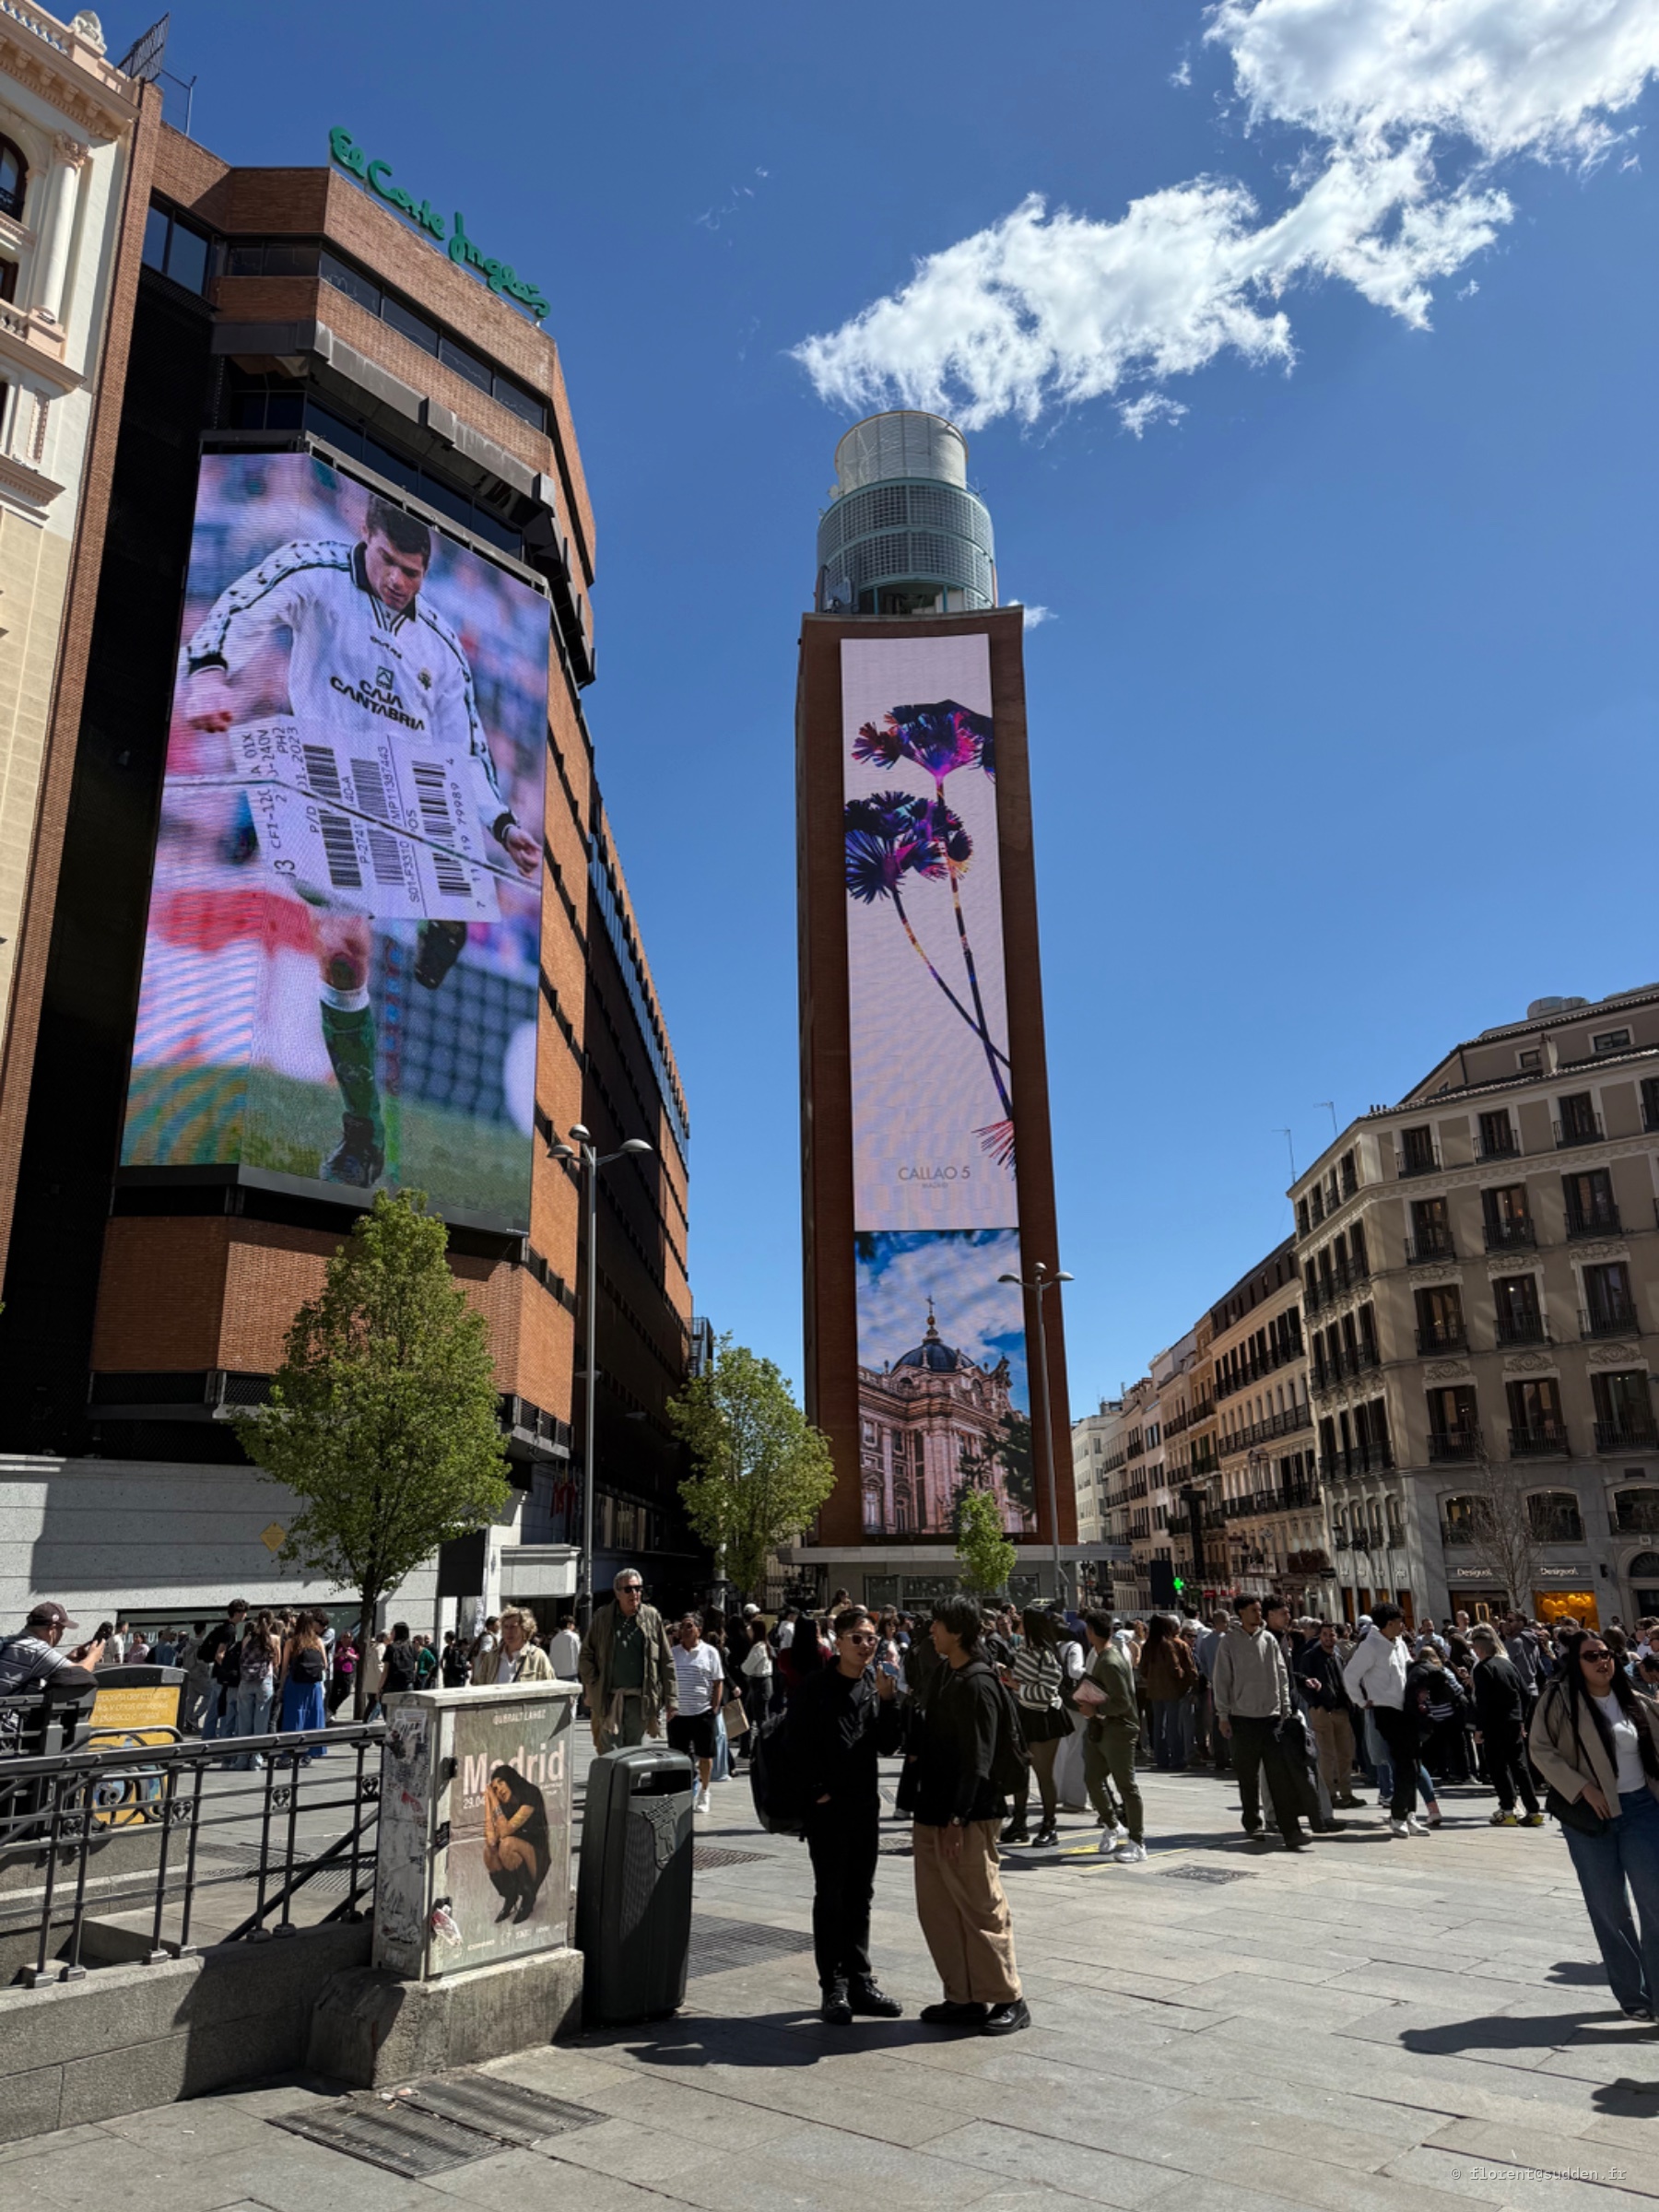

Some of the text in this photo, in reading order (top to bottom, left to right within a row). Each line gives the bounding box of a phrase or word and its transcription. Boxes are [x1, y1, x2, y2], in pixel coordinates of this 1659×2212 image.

[329, 125, 550, 319] El Corte Inglés
[330, 676, 425, 731] CANTABRIA
[359, 679, 403, 710] CAJA
[272, 726, 289, 754] PH2
[306, 806, 321, 833] P/D
[898, 1166, 971, 1181] CALLAO 5
